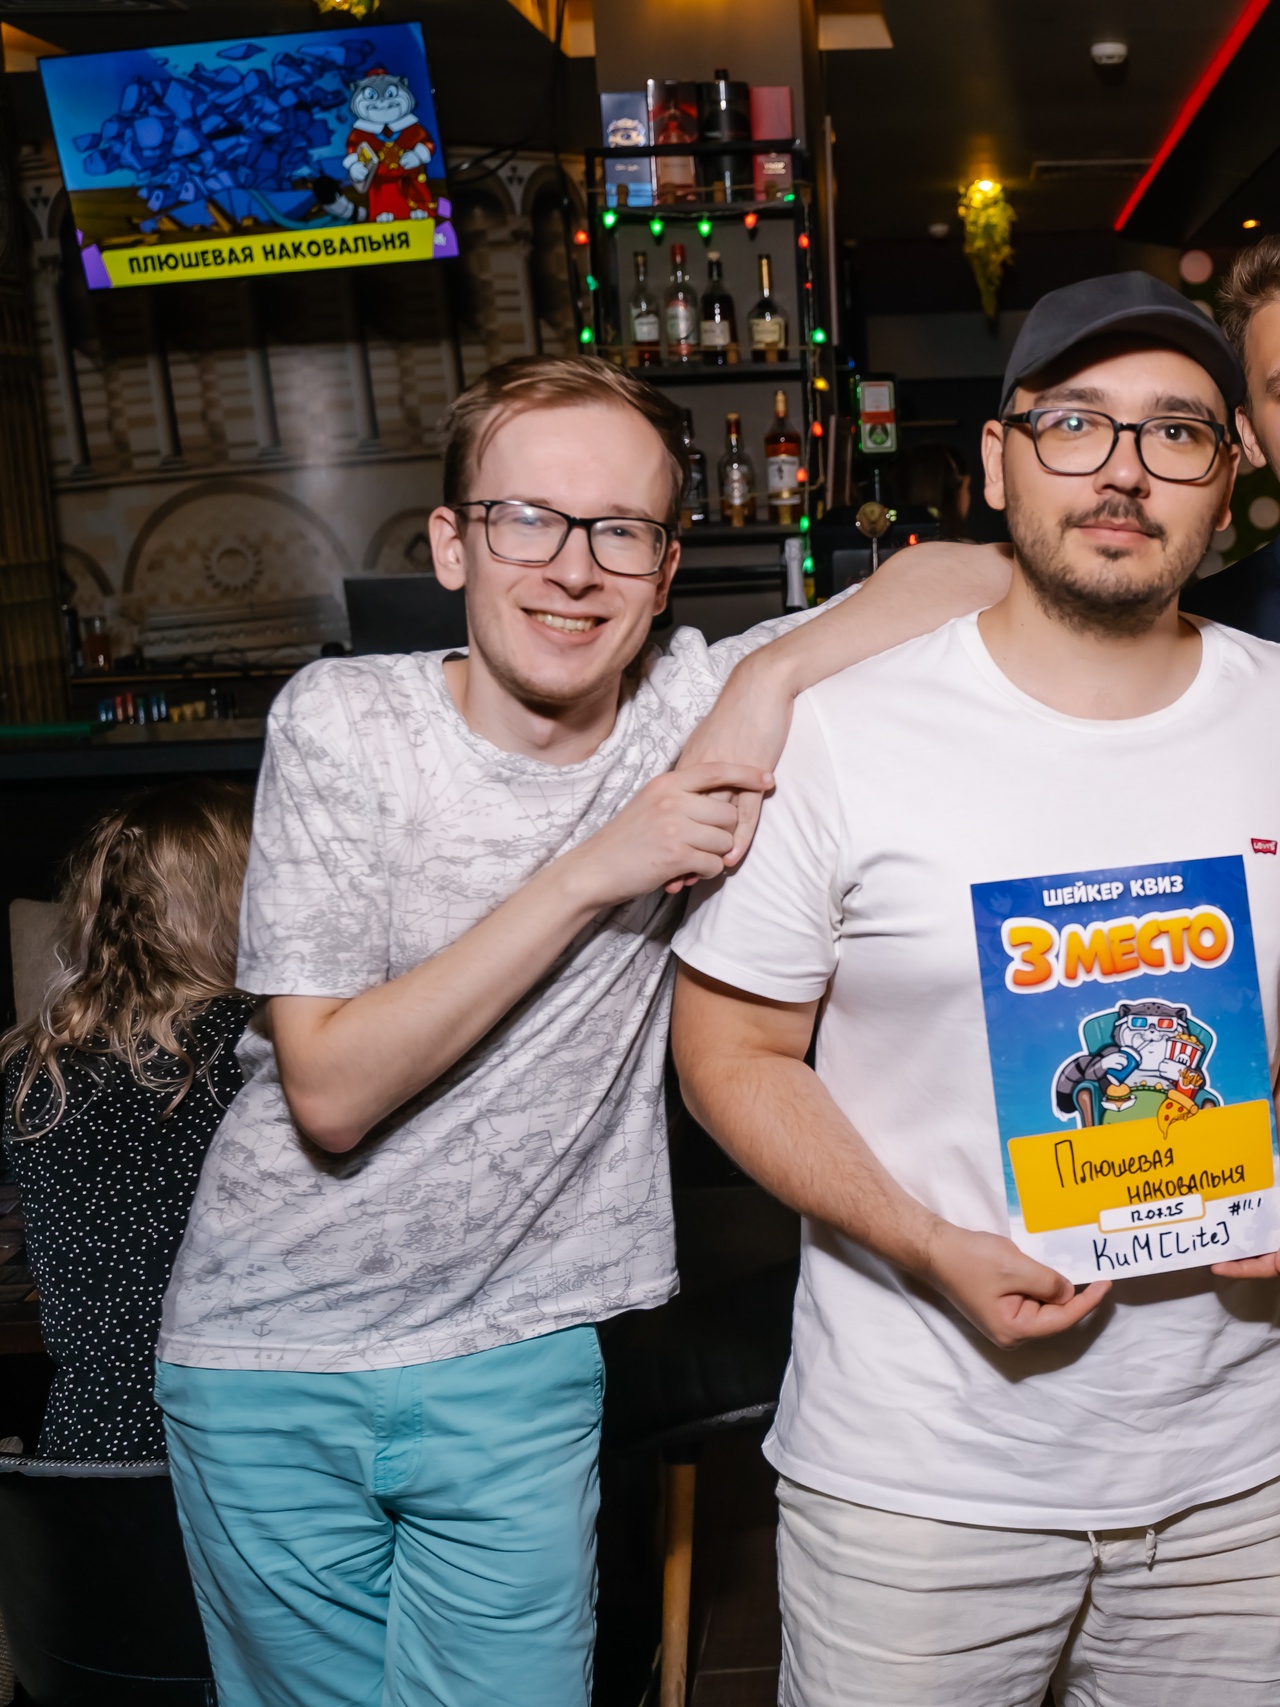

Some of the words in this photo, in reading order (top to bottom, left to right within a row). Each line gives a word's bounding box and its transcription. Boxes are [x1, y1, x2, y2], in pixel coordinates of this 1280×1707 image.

[128, 246, 254, 274] ПЛЮШЕВАЯ
[262, 231, 411, 262] НАКОВАЛЬНЯ
[1042, 881, 1124, 907] ШЕЙКЕР
[1130, 875, 1184, 899] КВИЗ
[1003, 920, 1056, 992] 3
[1060, 906, 1234, 985] МЕСТО
